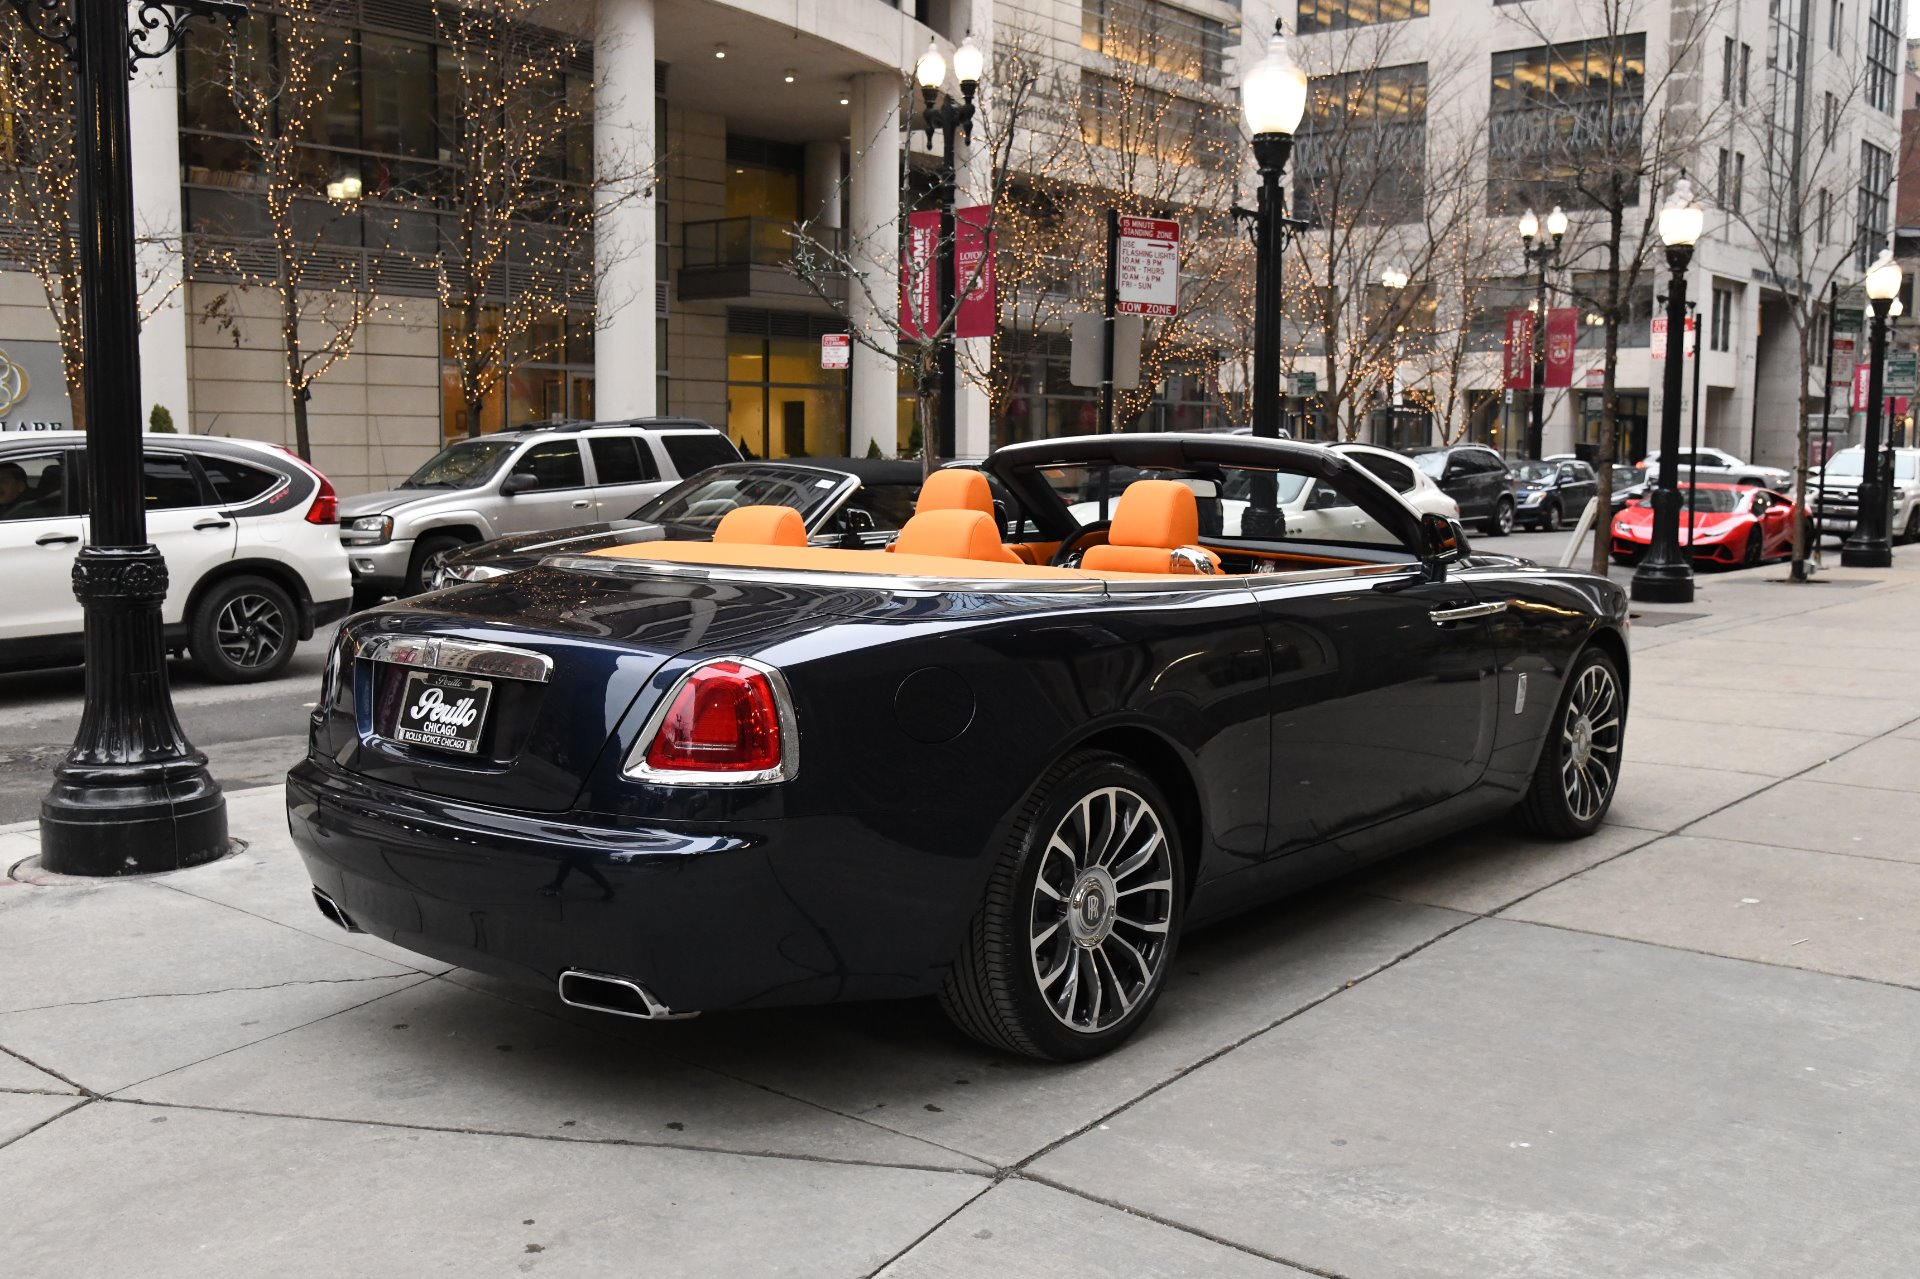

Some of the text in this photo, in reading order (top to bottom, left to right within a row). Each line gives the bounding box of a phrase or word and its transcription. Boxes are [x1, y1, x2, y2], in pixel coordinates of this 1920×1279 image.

[1123, 219, 1155, 229] 15 MINUTE
[1123, 228, 1173, 240] STANDING ZONE
[1122, 241, 1135, 249] USE
[1122, 249, 1176, 260] FLASHING LIGHTS
[912, 228, 925, 324] ELCOME
[1143, 267, 1165, 275] THURS
[1121, 302, 1172, 314] TOW ZONE
[410, 687, 477, 728] Perillo
[423, 721, 457, 736] CHICAGO
[405, 731, 465, 749] ROLLS ROYCE CHICAGO
